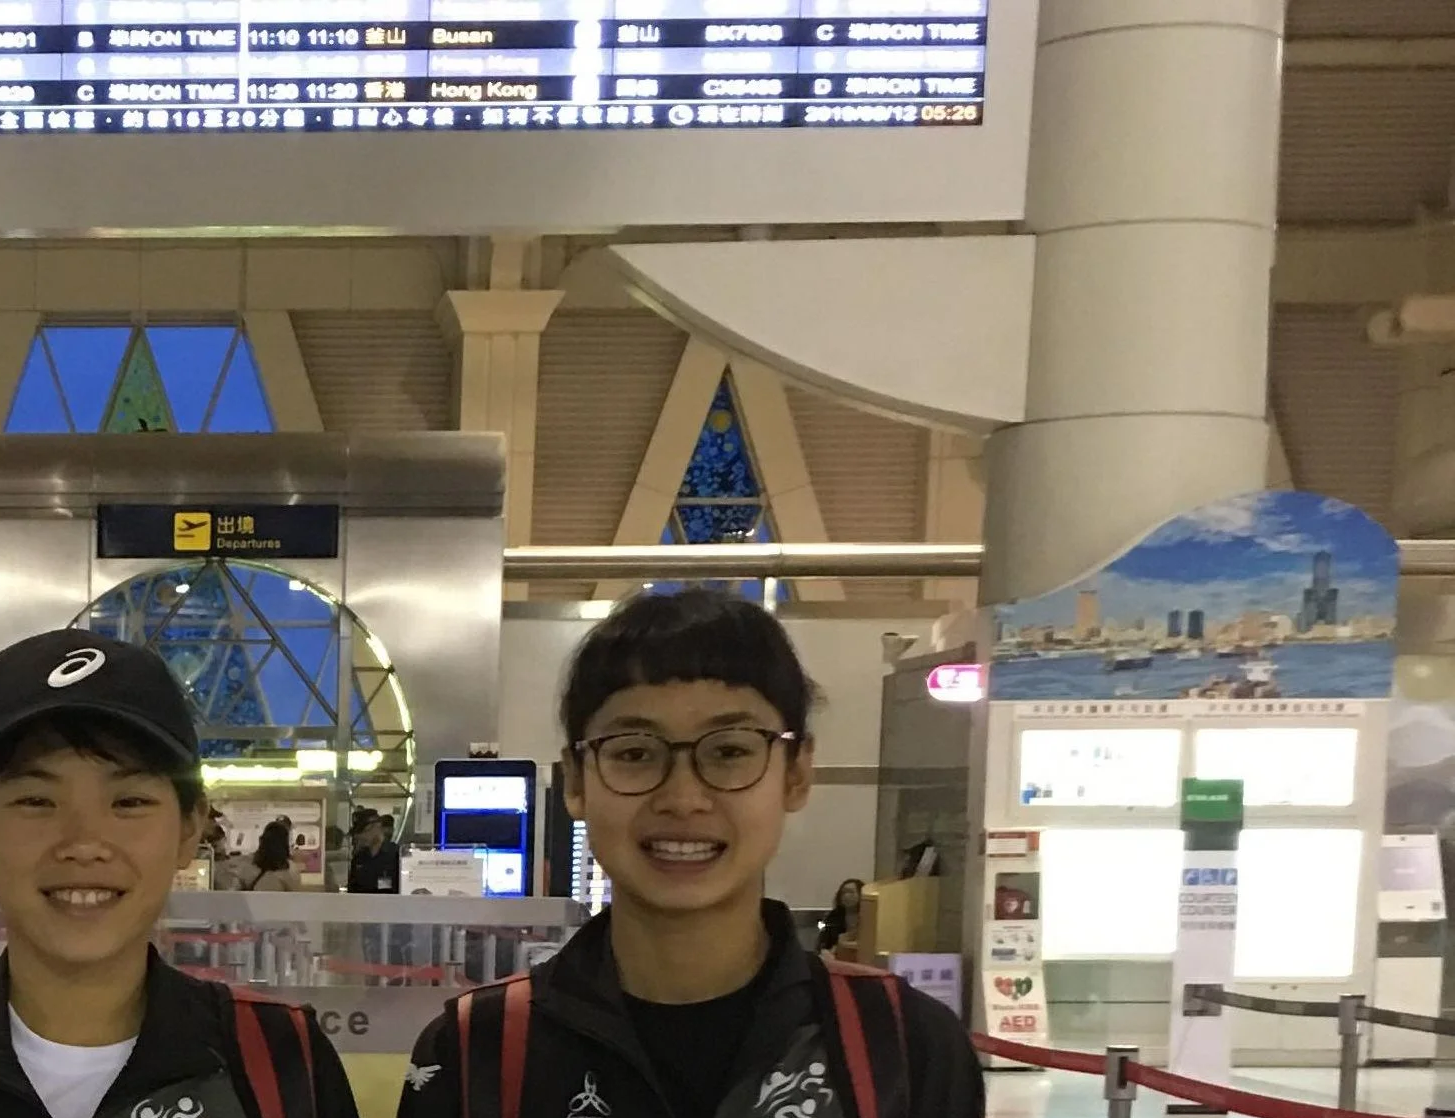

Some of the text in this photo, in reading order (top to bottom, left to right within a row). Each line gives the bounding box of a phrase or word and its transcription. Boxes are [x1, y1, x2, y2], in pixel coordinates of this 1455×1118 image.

[186, 29, 236, 47] TIME
[248, 29, 359, 46] 11:10 11:10
[432, 28, 493, 44] Busan
[185, 84, 235, 101] TIME
[431, 82, 537, 100] Hong Kong
[921, 105, 977, 121] 05:26
[217, 515, 255, 534] 出境
[217, 538, 281, 549] Departures
[1000, 1015, 1037, 1027] AED
